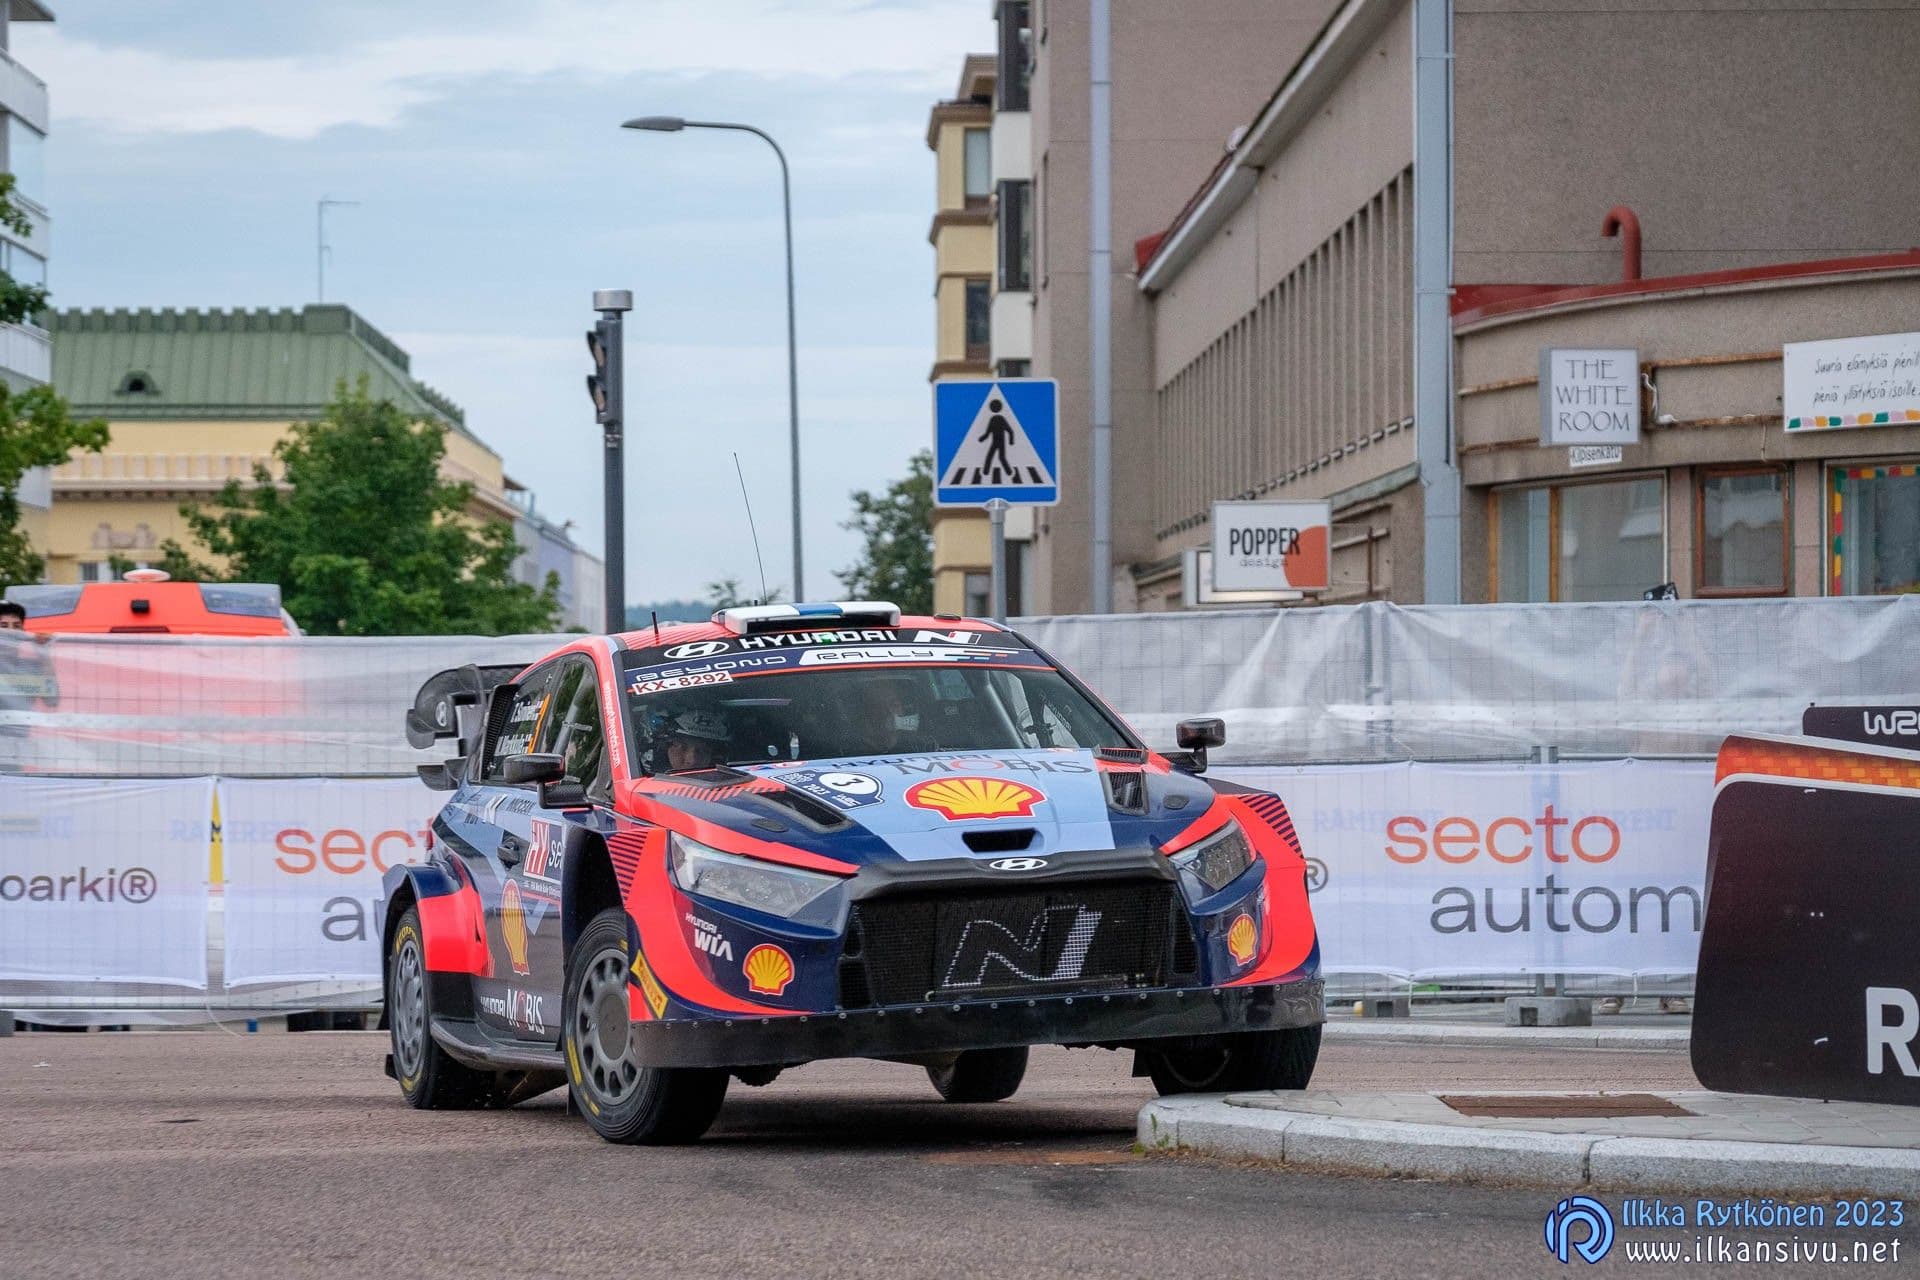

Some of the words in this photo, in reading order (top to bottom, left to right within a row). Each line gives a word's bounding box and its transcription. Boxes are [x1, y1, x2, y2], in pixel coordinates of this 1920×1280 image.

[1565, 359, 1618, 379] THE
[1815, 356, 1842, 374] Suuria
[1555, 385, 1633, 405] WHITE
[1812, 385, 1840, 407] pieniä
[1559, 410, 1630, 432] ROOM
[1230, 527, 1302, 556] POPPER
[1239, 558, 1288, 569] design
[739, 630, 897, 650] HYUNDAI
[636, 655, 787, 682] BEYOND
[816, 651, 934, 660] RALLY
[634, 672, 730, 694] KX-8292
[1863, 710, 1920, 735] WR
[832, 754, 992, 769] HYUNDAI
[897, 759, 1093, 775] MOBIS
[1385, 803, 1621, 864] secto
[549, 840, 561, 869] se
[1430, 874, 1702, 934] autom
[685, 912, 718, 933] HYUNDAI
[694, 929, 733, 961] WIA
[506, 989, 545, 1034] MOBIS
[1866, 986, 1920, 1077] R
